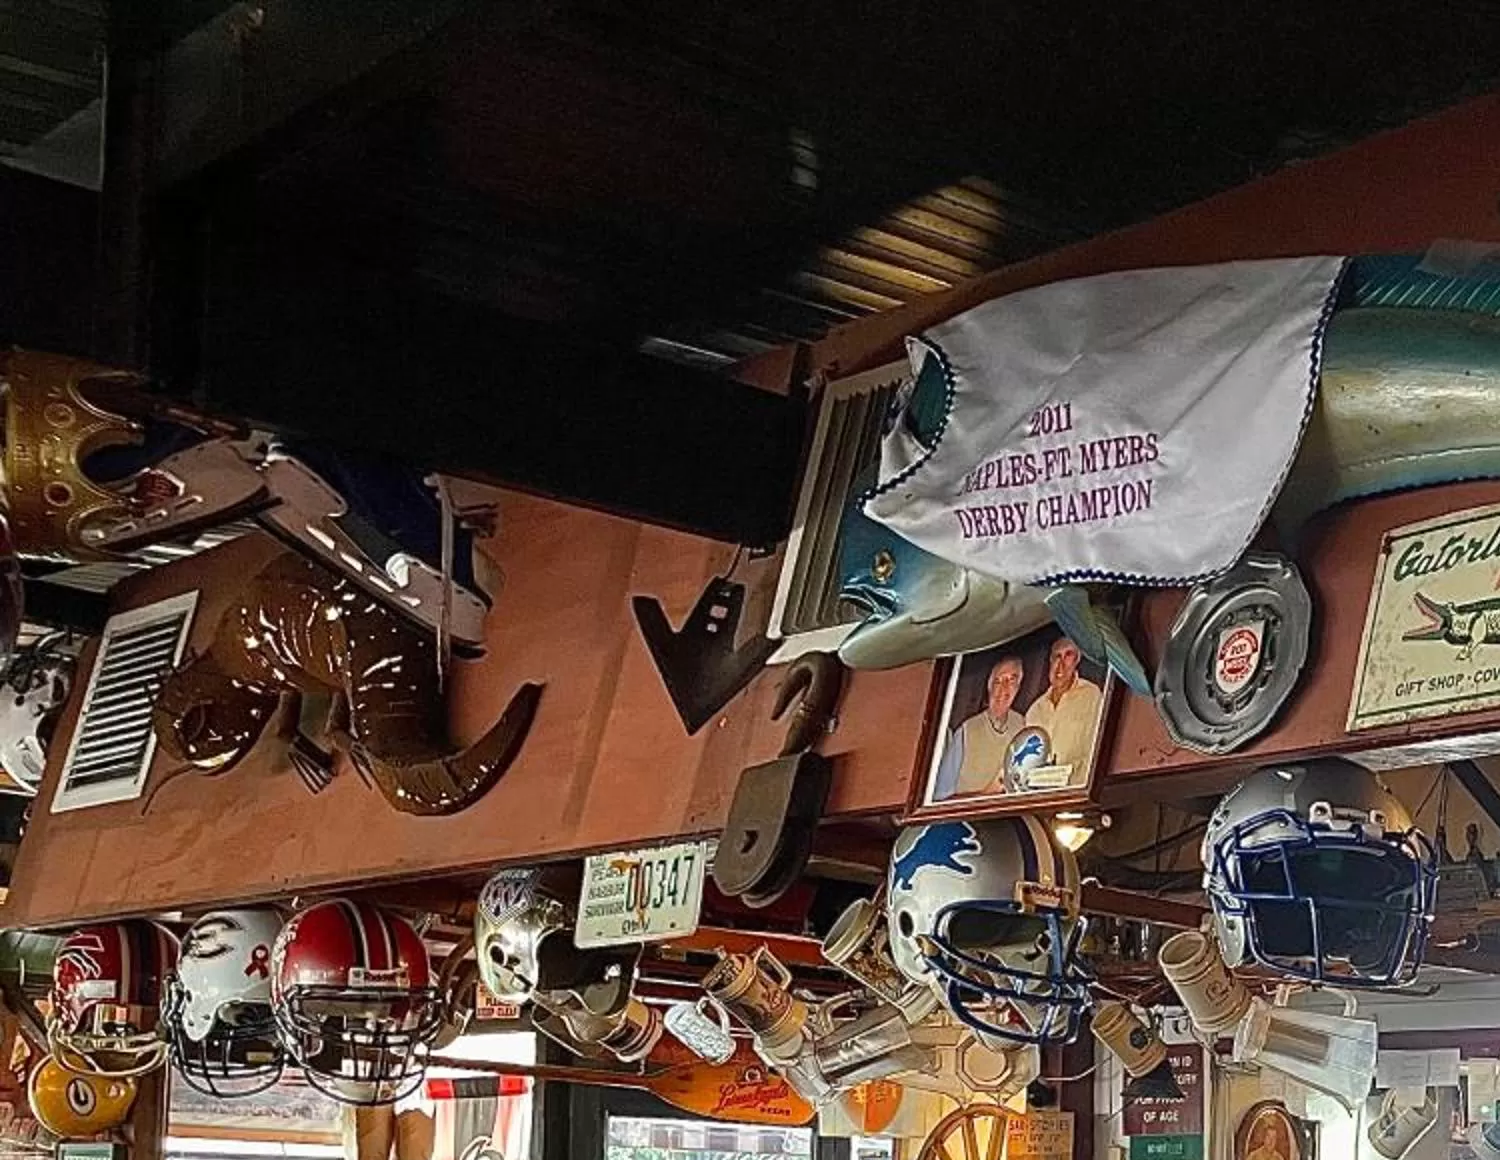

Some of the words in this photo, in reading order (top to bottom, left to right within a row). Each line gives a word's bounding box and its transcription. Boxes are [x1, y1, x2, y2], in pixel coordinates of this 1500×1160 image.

[1028, 403, 1072, 437] 2011
[1080, 433, 1158, 475] MYERS
[955, 502, 1029, 538] DERBY
[1037, 480, 1153, 530] CHAMPION
[1396, 681, 1423, 697] GIFT
[1428, 674, 1464, 692] SHOP
[1143, 1111, 1157, 1123] OF
[1160, 1111, 1179, 1122] AGE
